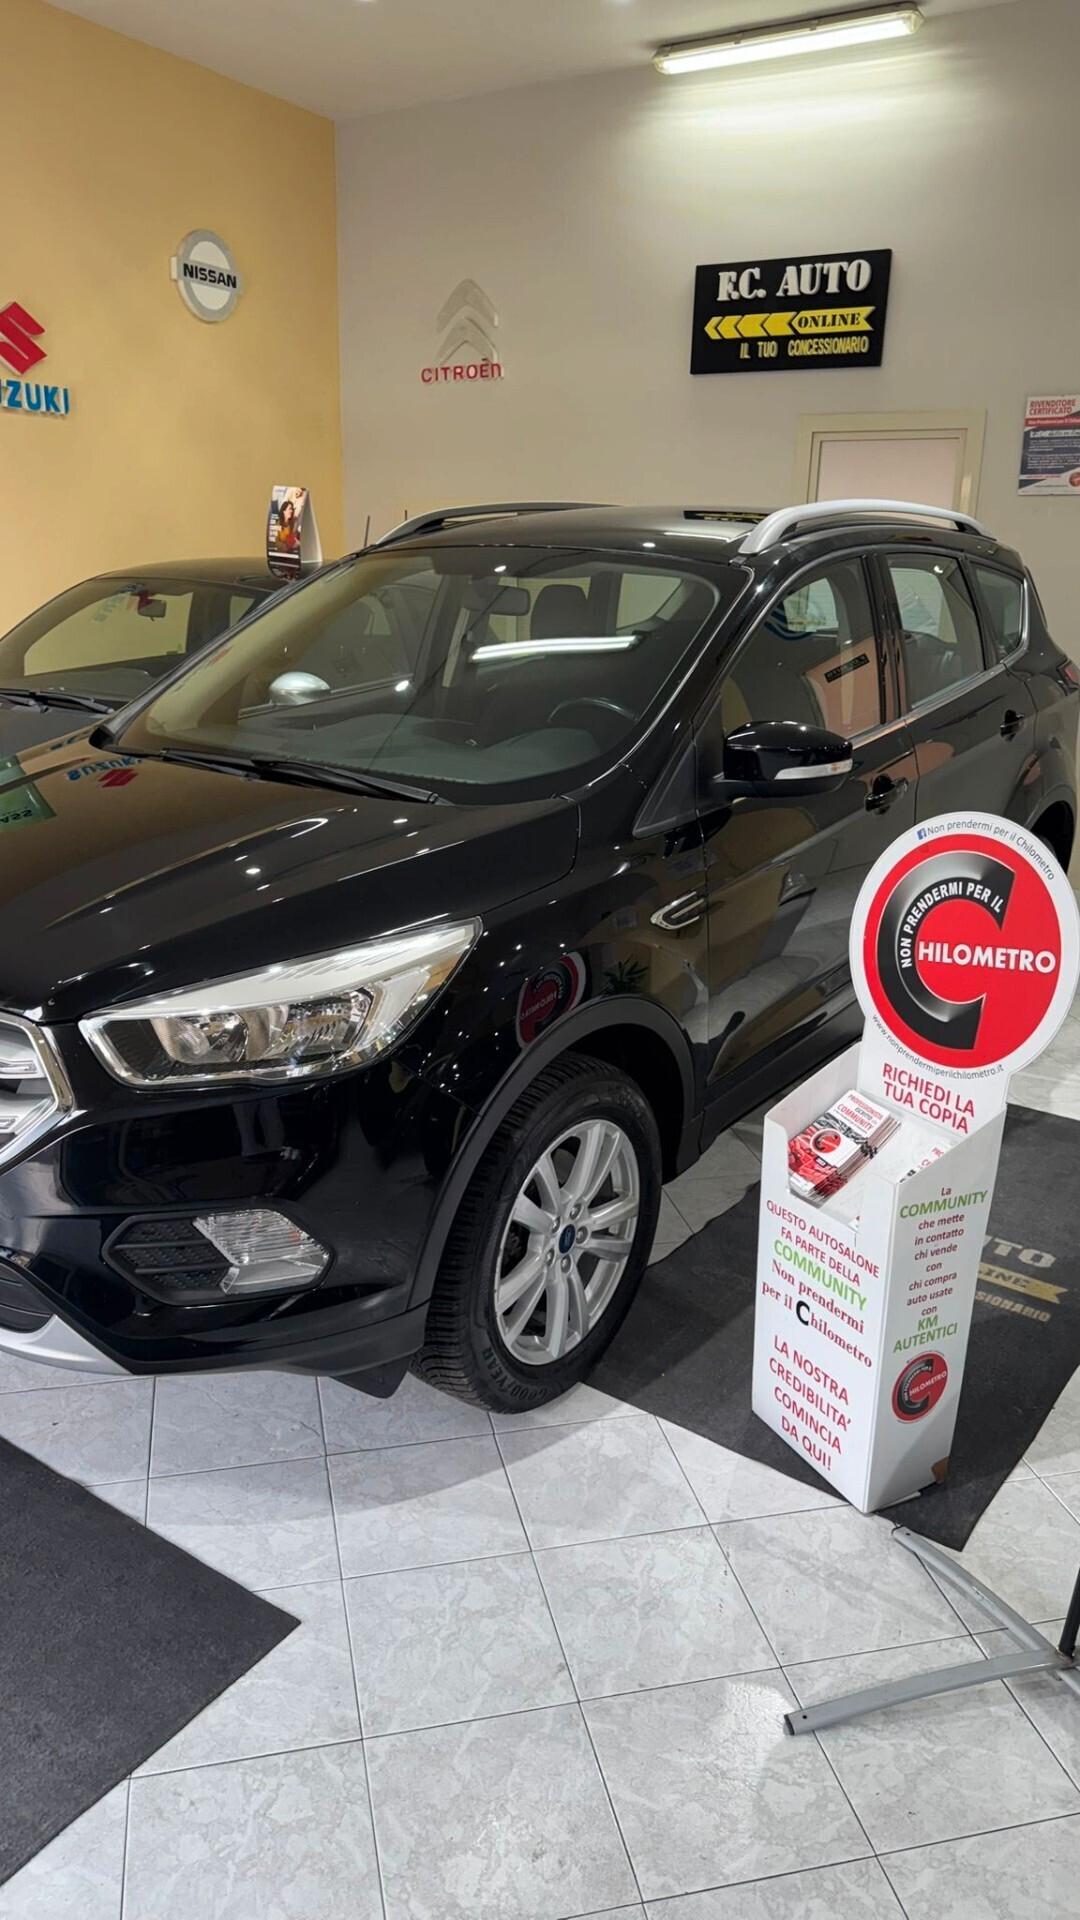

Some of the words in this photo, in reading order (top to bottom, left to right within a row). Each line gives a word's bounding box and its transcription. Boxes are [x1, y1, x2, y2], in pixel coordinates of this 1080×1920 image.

[183, 263, 237, 289] NISSAN
[716, 267, 767, 301] F.C.
[776, 259, 872, 297] AUTO
[798, 312, 861, 329] ONLINE
[740, 343, 750, 359] IL
[757, 341, 778, 358] TUO
[787, 336, 870, 357] CONCESSIONARIO
[0, 378, 70, 415] ZUKI
[928, 825, 945, 835] Non
[947, 820, 992, 831] prendermi
[994, 825, 1009, 838] per
[1009, 830, 1017, 841] il
[1016, 837, 1055, 881] Chilometro
[966, 882, 992, 903] PER
[991, 895, 1004, 913] IL
[903, 881, 963, 934] PRENDERMI
[900, 938, 912, 968] NON
[883, 1063, 951, 1105] RICHIEDI
[955, 1095, 975, 1118] LA
[837, 1104, 873, 1131] COMMUNITY
[883, 1081, 914, 1109] TUA
[919, 1098, 969, 1134] COPIA
[900, 1190, 988, 1219] COMMUNITY
[941, 1187, 952, 1196] La
[918, 1219, 935, 1230] che
[937, 1213, 965, 1227] mette
[766, 1200, 807, 1231] QUESTO
[808, 1225, 880, 1278] AUTOSALONE
[914, 1236, 924, 1246] in
[925, 1228, 964, 1243] contatto
[780, 1226, 793, 1242] FA
[795, 1235, 826, 1263] PARTE
[828, 1257, 861, 1287] DELLA
[914, 1249, 928, 1261] chi
[930, 1243, 958, 1258] vende
[774, 1239, 867, 1311] COMMUNITY
[926, 1262, 942, 1272] con
[978, 1267, 1030, 1289] INE
[772, 1259, 795, 1286] Non
[798, 1281, 864, 1334] prendermi
[906, 1293, 928, 1306] auto
[930, 1287, 953, 1300] usate
[908, 1279, 922, 1291] chi
[924, 1273, 957, 1290] compra
[921, 1306, 937, 1316] con
[975, 1291, 1051, 1322] SIONARIO
[762, 1281, 781, 1301] per
[784, 1294, 793, 1311] il
[796, 1300, 873, 1368] Chilometro
[917, 1314, 938, 1331] KM
[893, 1322, 958, 1353] AUTENTICI
[774, 1335, 789, 1359] LA
[793, 1350, 849, 1405] NOSTRA
[774, 1386, 841, 1454] COMINCIA
[781, 1415, 799, 1442] DA
[802, 1435, 832, 1471] QUI!
